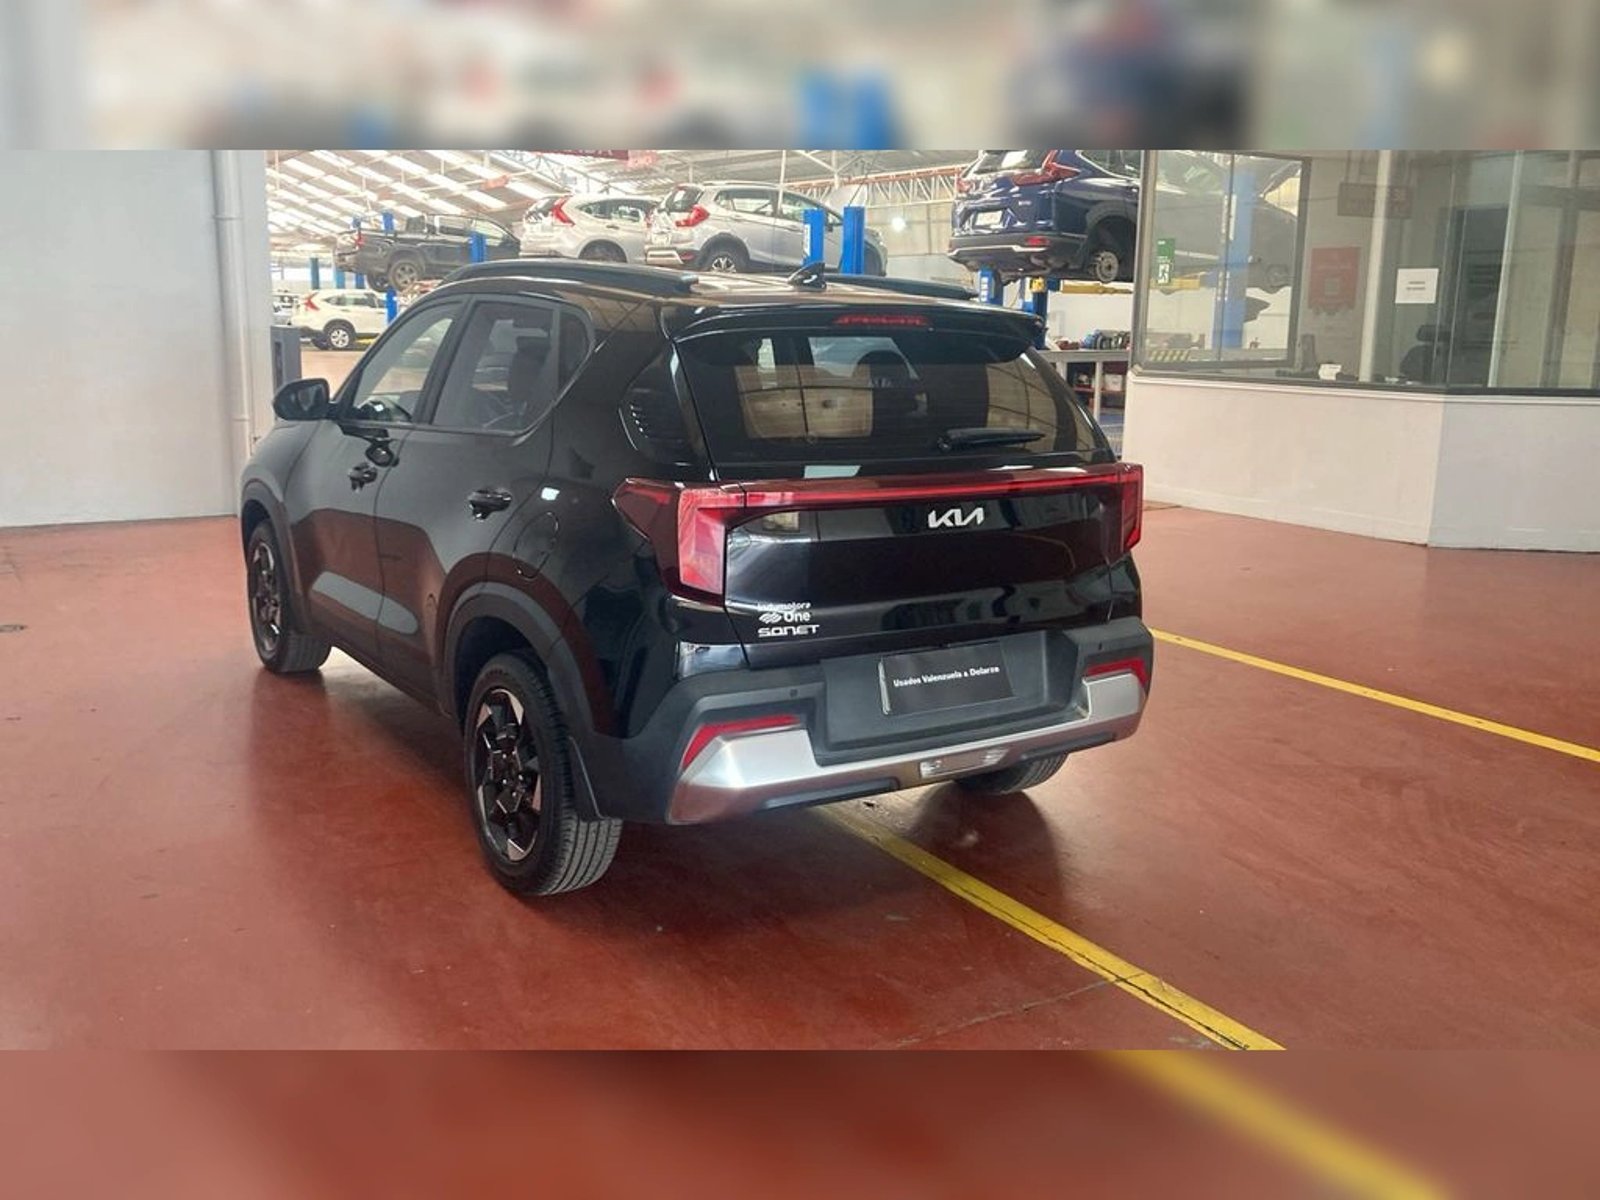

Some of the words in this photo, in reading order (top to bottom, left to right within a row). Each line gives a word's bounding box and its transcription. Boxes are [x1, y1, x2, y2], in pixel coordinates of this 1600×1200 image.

[928, 507, 984, 528] KIA
[783, 611, 811, 623] One
[757, 624, 820, 637] SONET
[893, 678, 921, 687] Usados
[921, 670, 962, 683] Valenzuela
